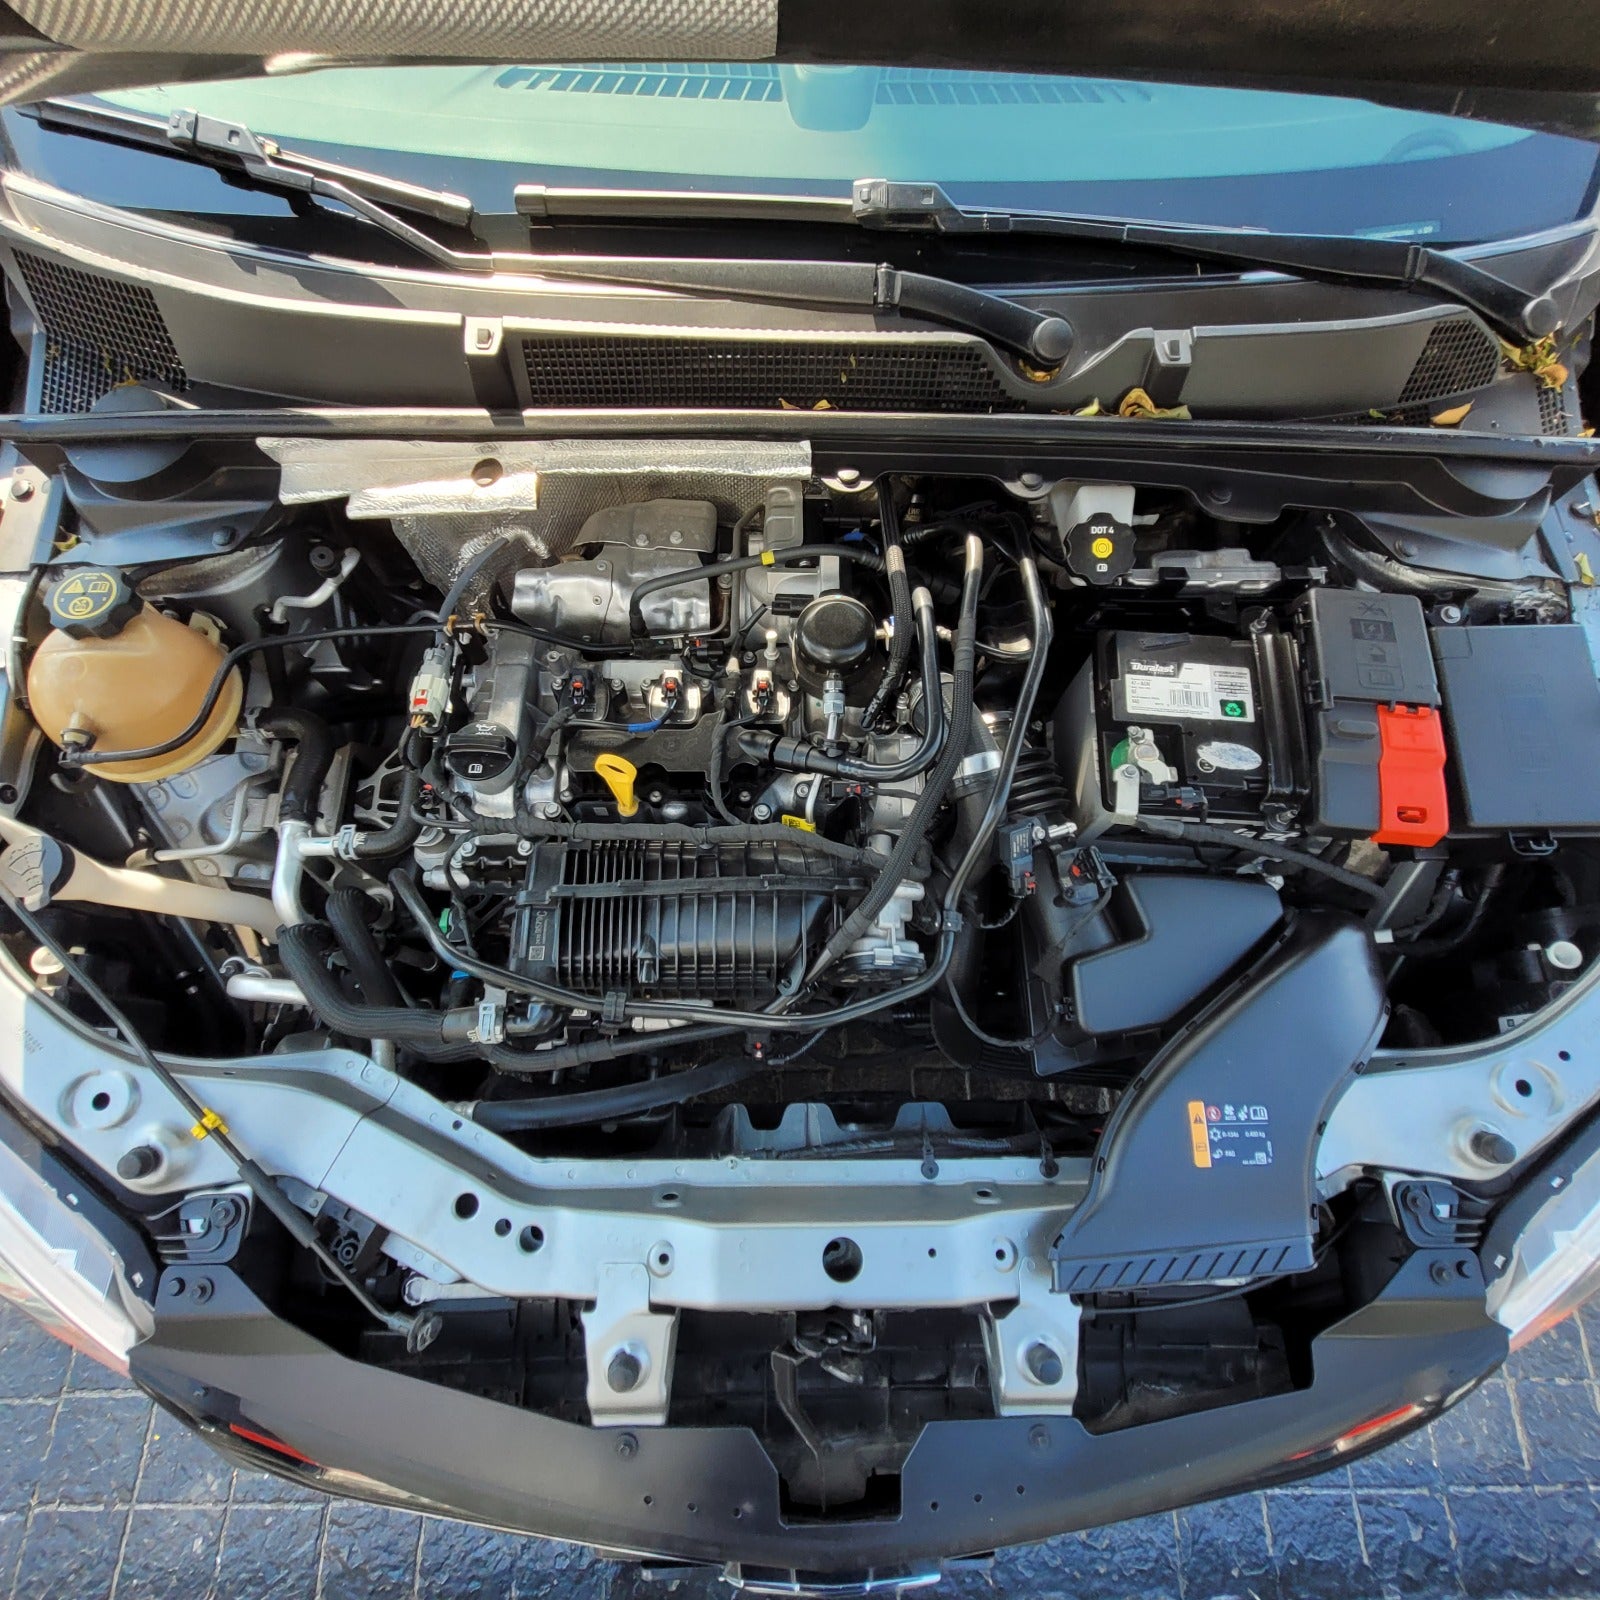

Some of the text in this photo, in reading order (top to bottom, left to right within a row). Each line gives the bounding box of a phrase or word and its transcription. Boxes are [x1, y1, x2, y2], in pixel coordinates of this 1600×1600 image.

[1091, 526, 1114, 534] DOT 4
[1130, 662, 1174, 673] Duralast
